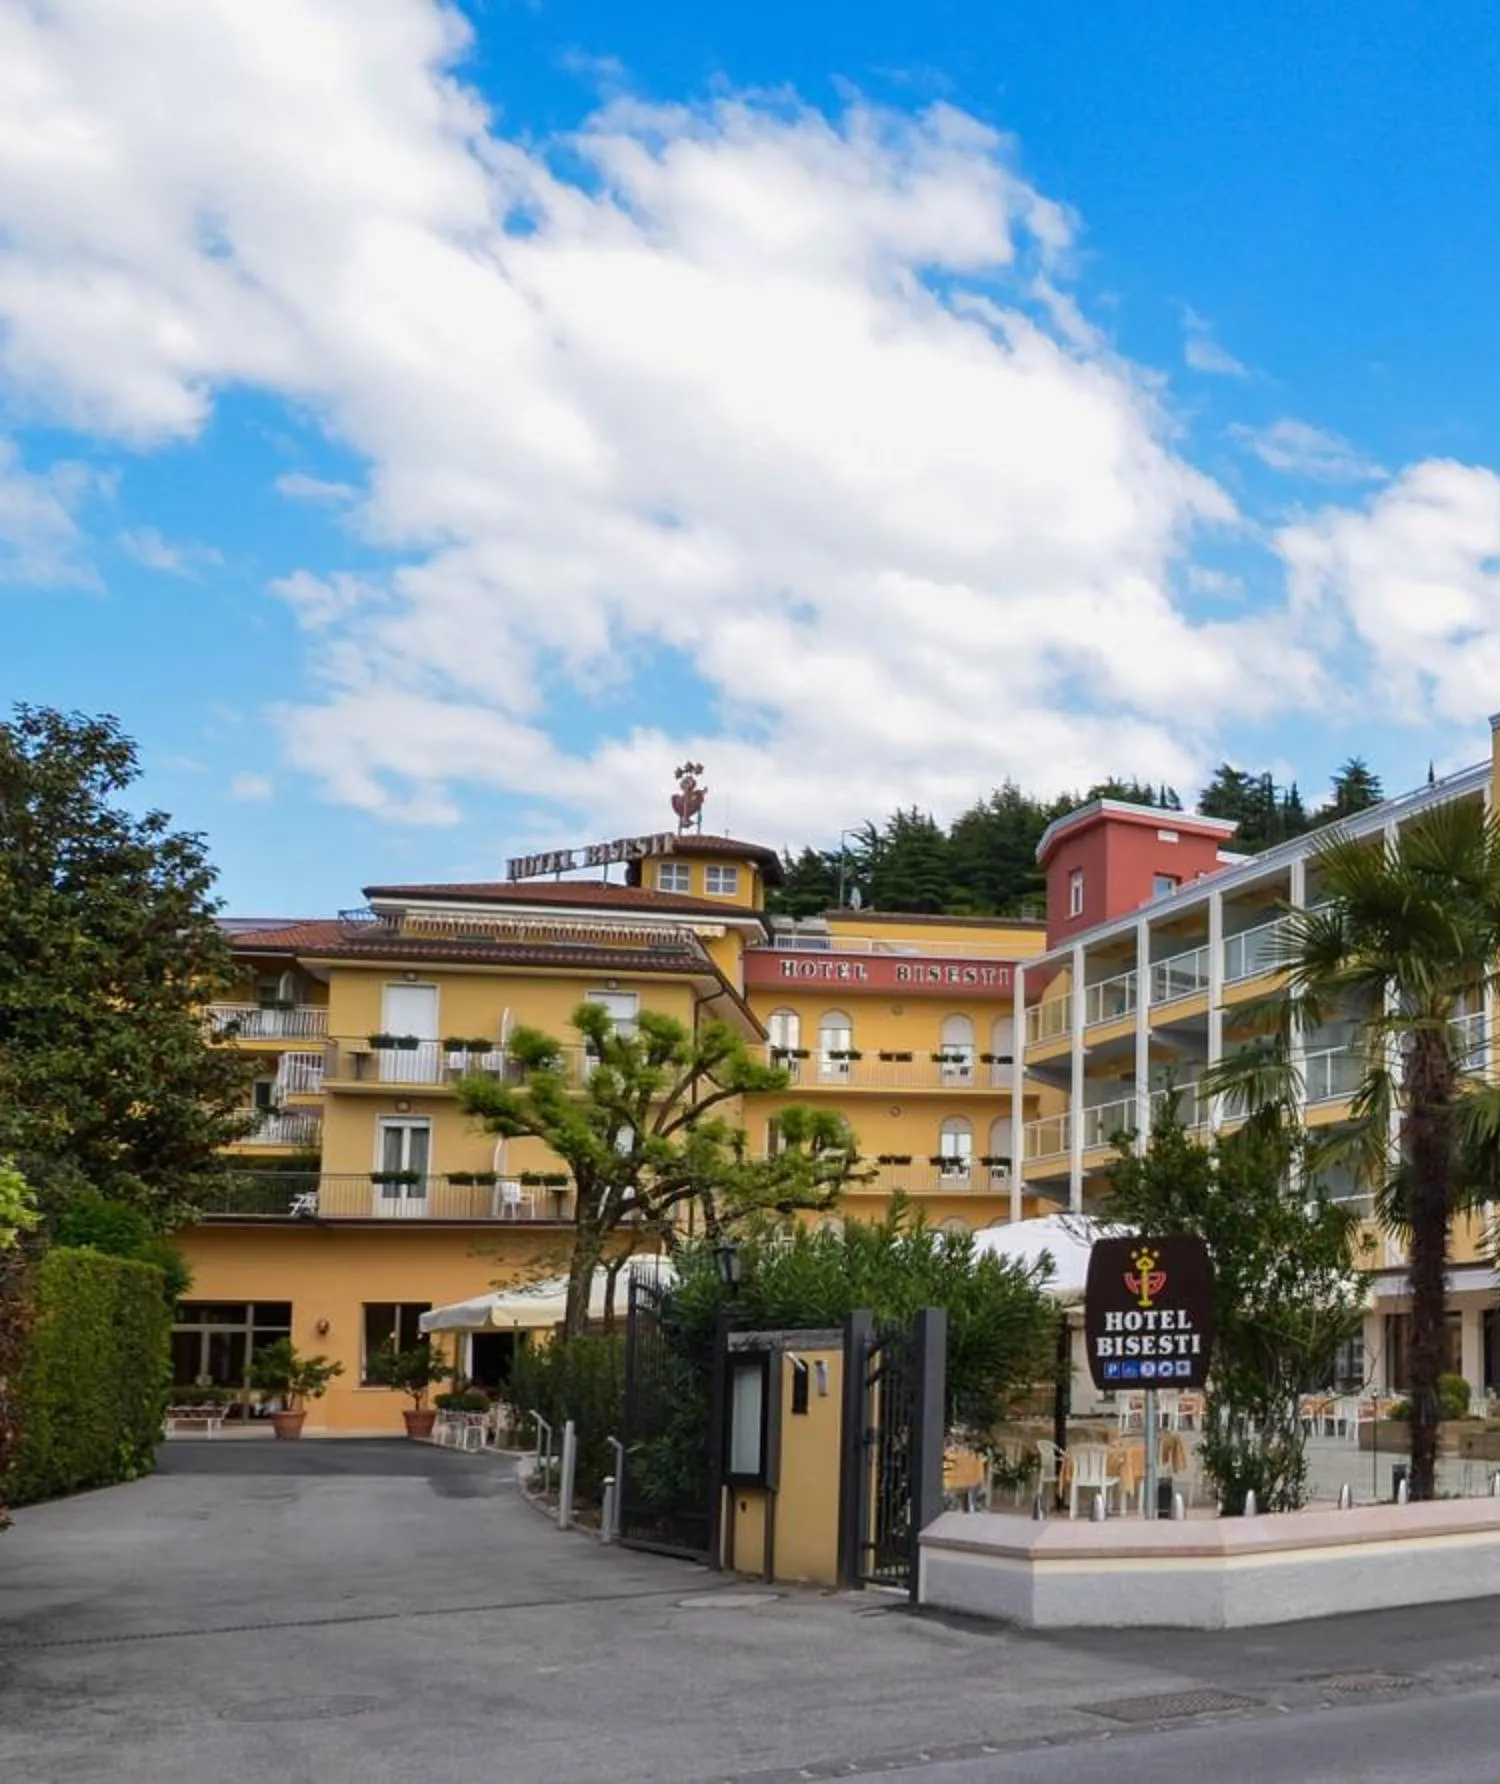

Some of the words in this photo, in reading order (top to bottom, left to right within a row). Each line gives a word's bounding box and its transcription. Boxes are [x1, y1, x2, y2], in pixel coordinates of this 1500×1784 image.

[780, 959, 868, 982] HOTEL
[896, 963, 1009, 985] BISESTI
[1104, 1309, 1192, 1331] HOTEL
[1096, 1334, 1201, 1357] BISESTI
